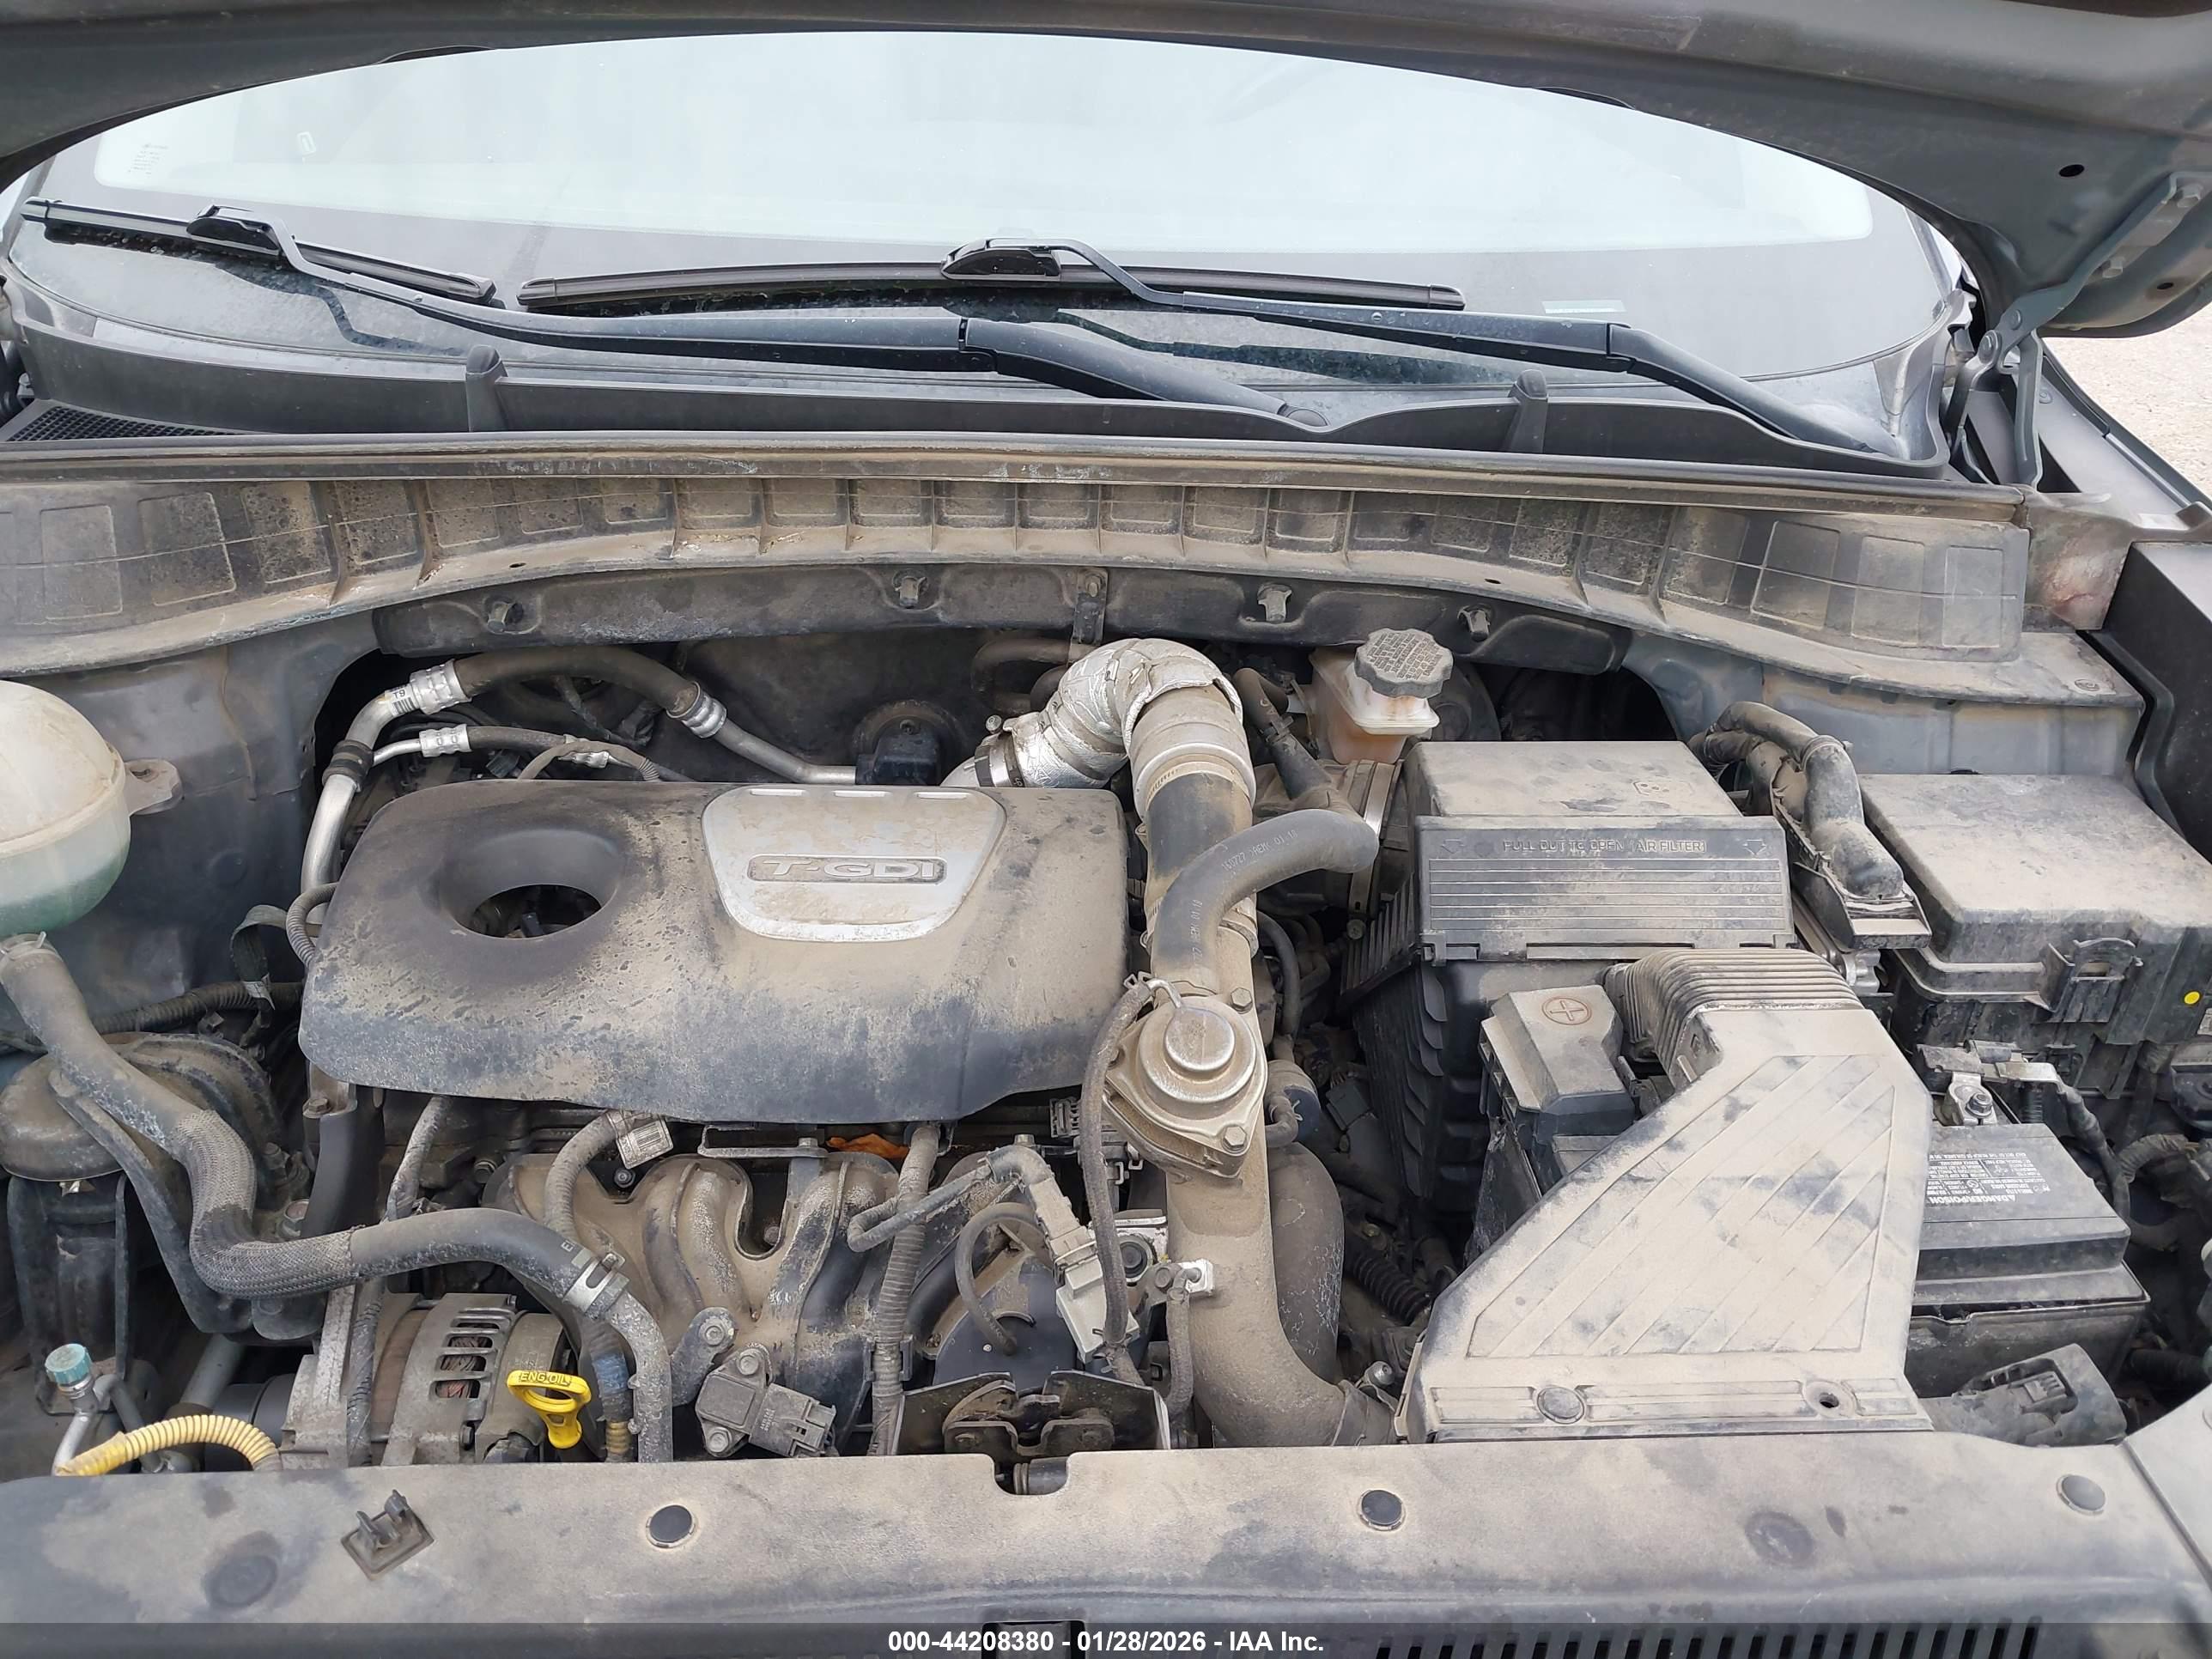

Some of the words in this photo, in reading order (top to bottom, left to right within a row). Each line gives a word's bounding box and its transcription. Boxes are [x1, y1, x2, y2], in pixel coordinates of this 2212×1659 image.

[392, 689, 405, 699] T9
[1503, 839, 1536, 852] PULL
[1539, 839, 1565, 853] OUT
[1589, 839, 1625, 853] OPEN
[1659, 839, 1706, 853] FILTER)
[763, 860, 934, 878] T-GDI
[520, 1371, 547, 1382] ENG
[548, 1374, 571, 1386] OIL
